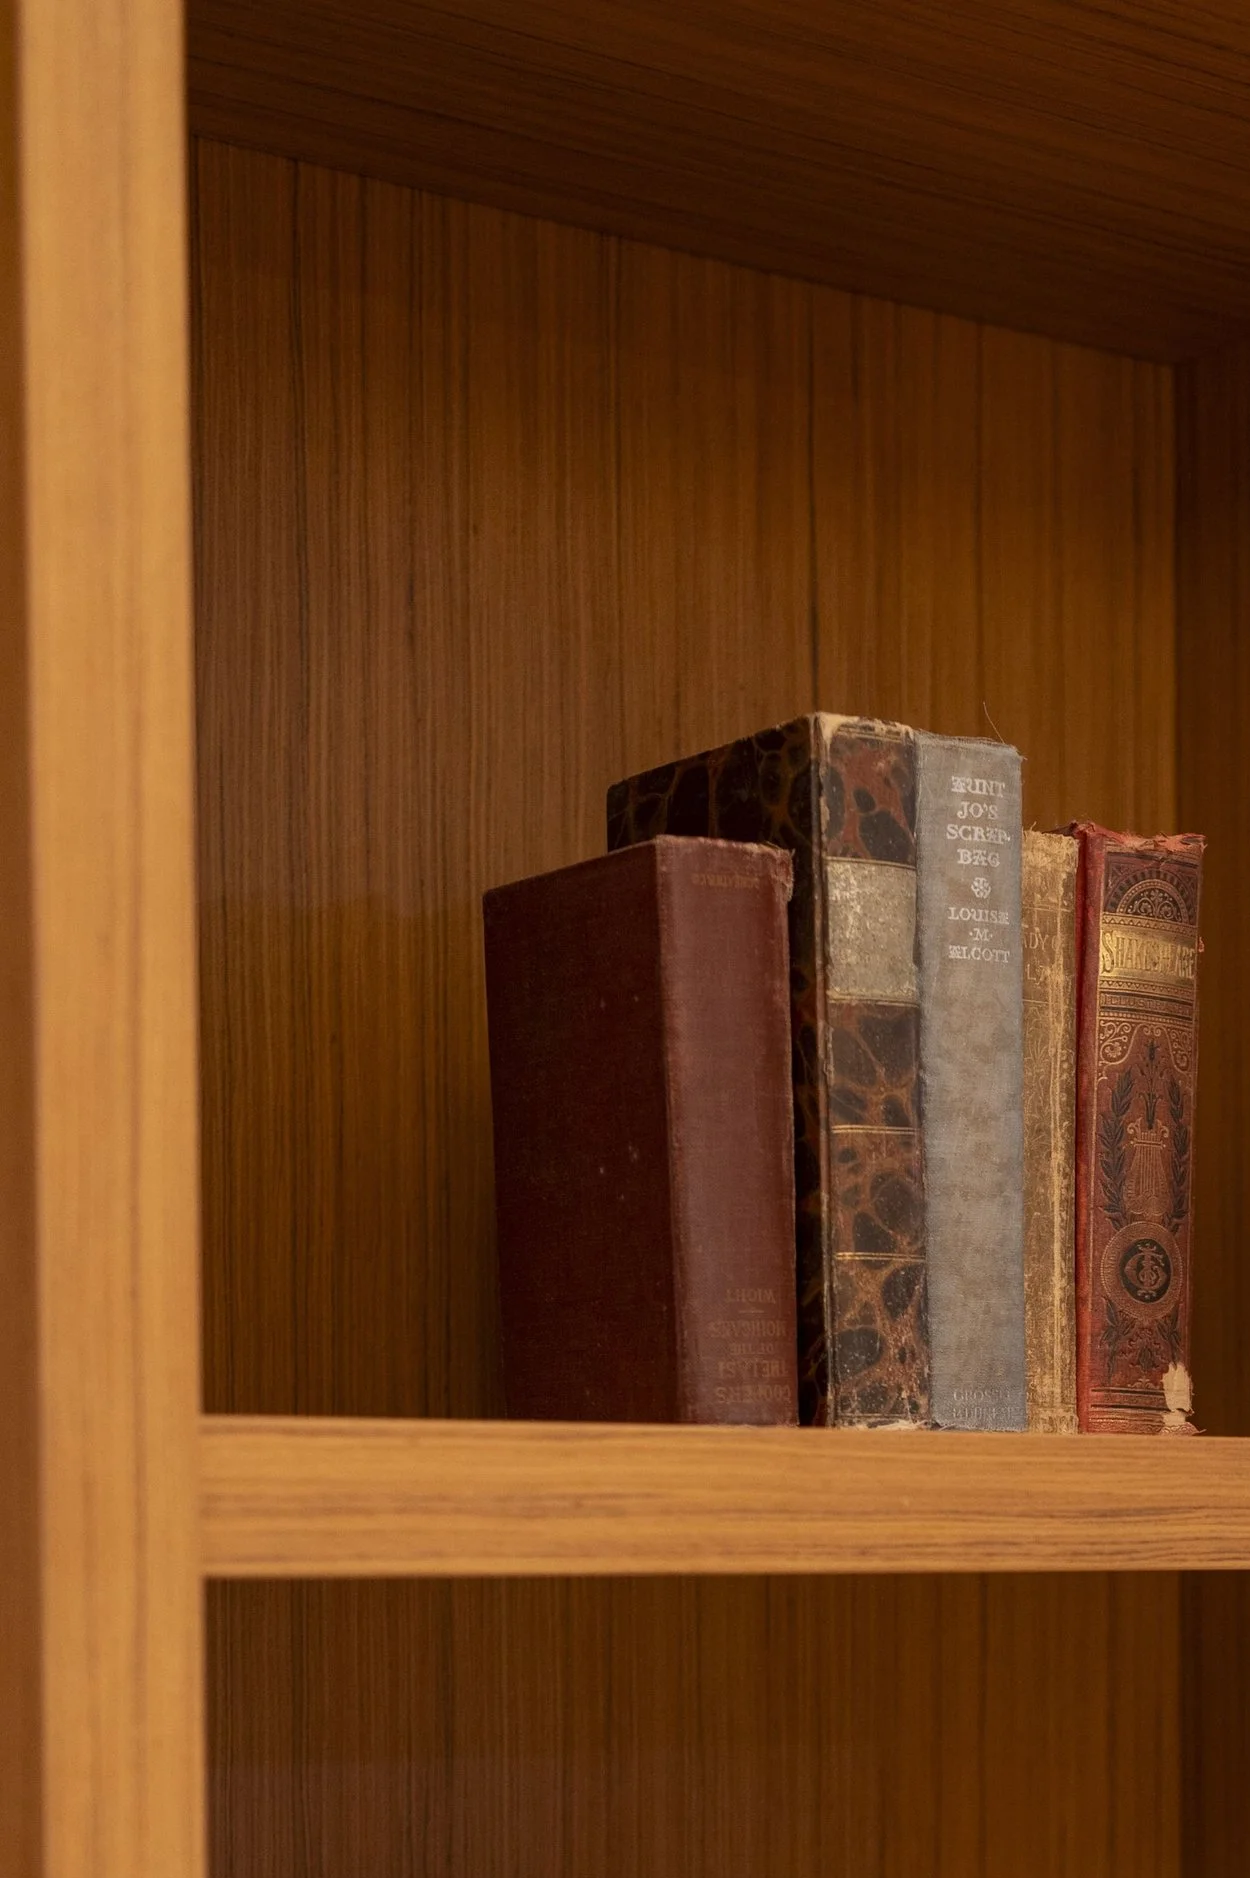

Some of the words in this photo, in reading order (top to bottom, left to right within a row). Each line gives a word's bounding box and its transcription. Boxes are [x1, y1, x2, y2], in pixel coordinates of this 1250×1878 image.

[951, 775, 1006, 798] AUNT
[957, 801, 1000, 820] JO'S
[957, 848, 1001, 867] BAG
[948, 906, 1010, 925] LOUISE
[948, 945, 1011, 964] ALCOTT
